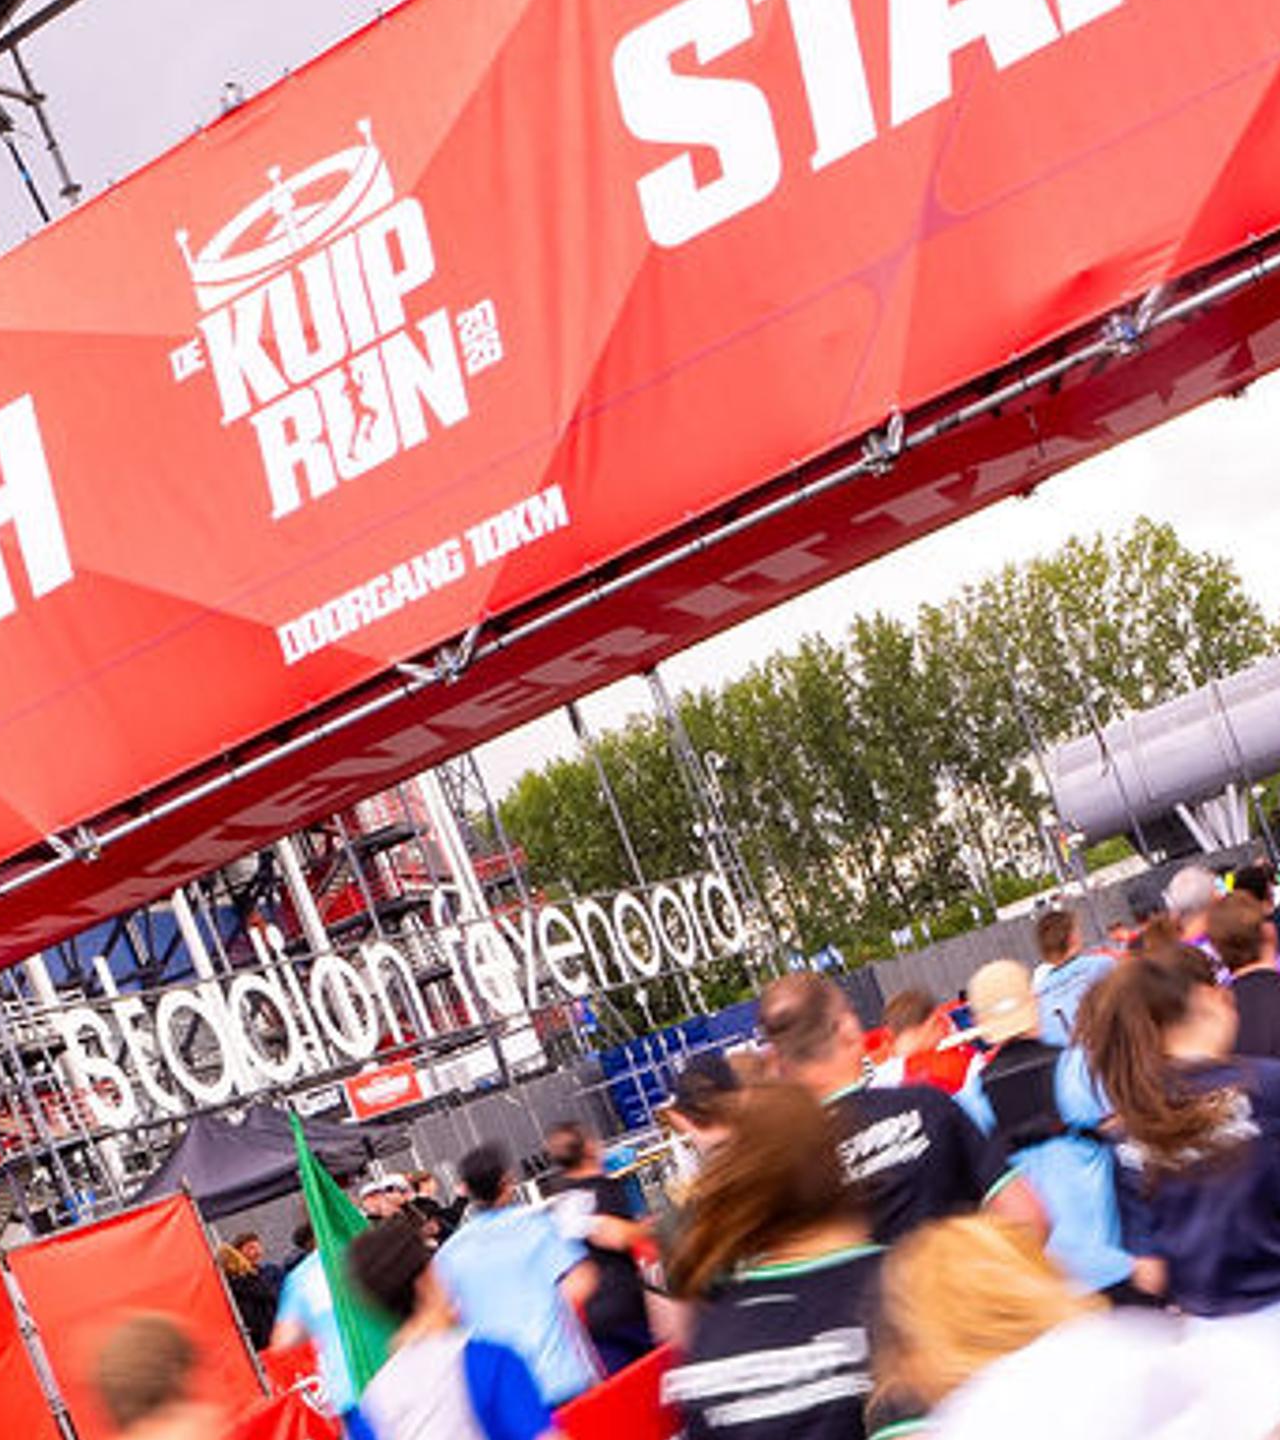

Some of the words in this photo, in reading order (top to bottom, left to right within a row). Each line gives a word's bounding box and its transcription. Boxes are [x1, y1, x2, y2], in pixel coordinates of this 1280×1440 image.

[168, 338, 206, 383] DE
[197, 197, 436, 426] KUIP
[249, 307, 470, 520] RUN
[275, 539, 468, 666] DOORGANG
[464, 484, 571, 568] 10KM
[670, 532, 829, 620] IT
